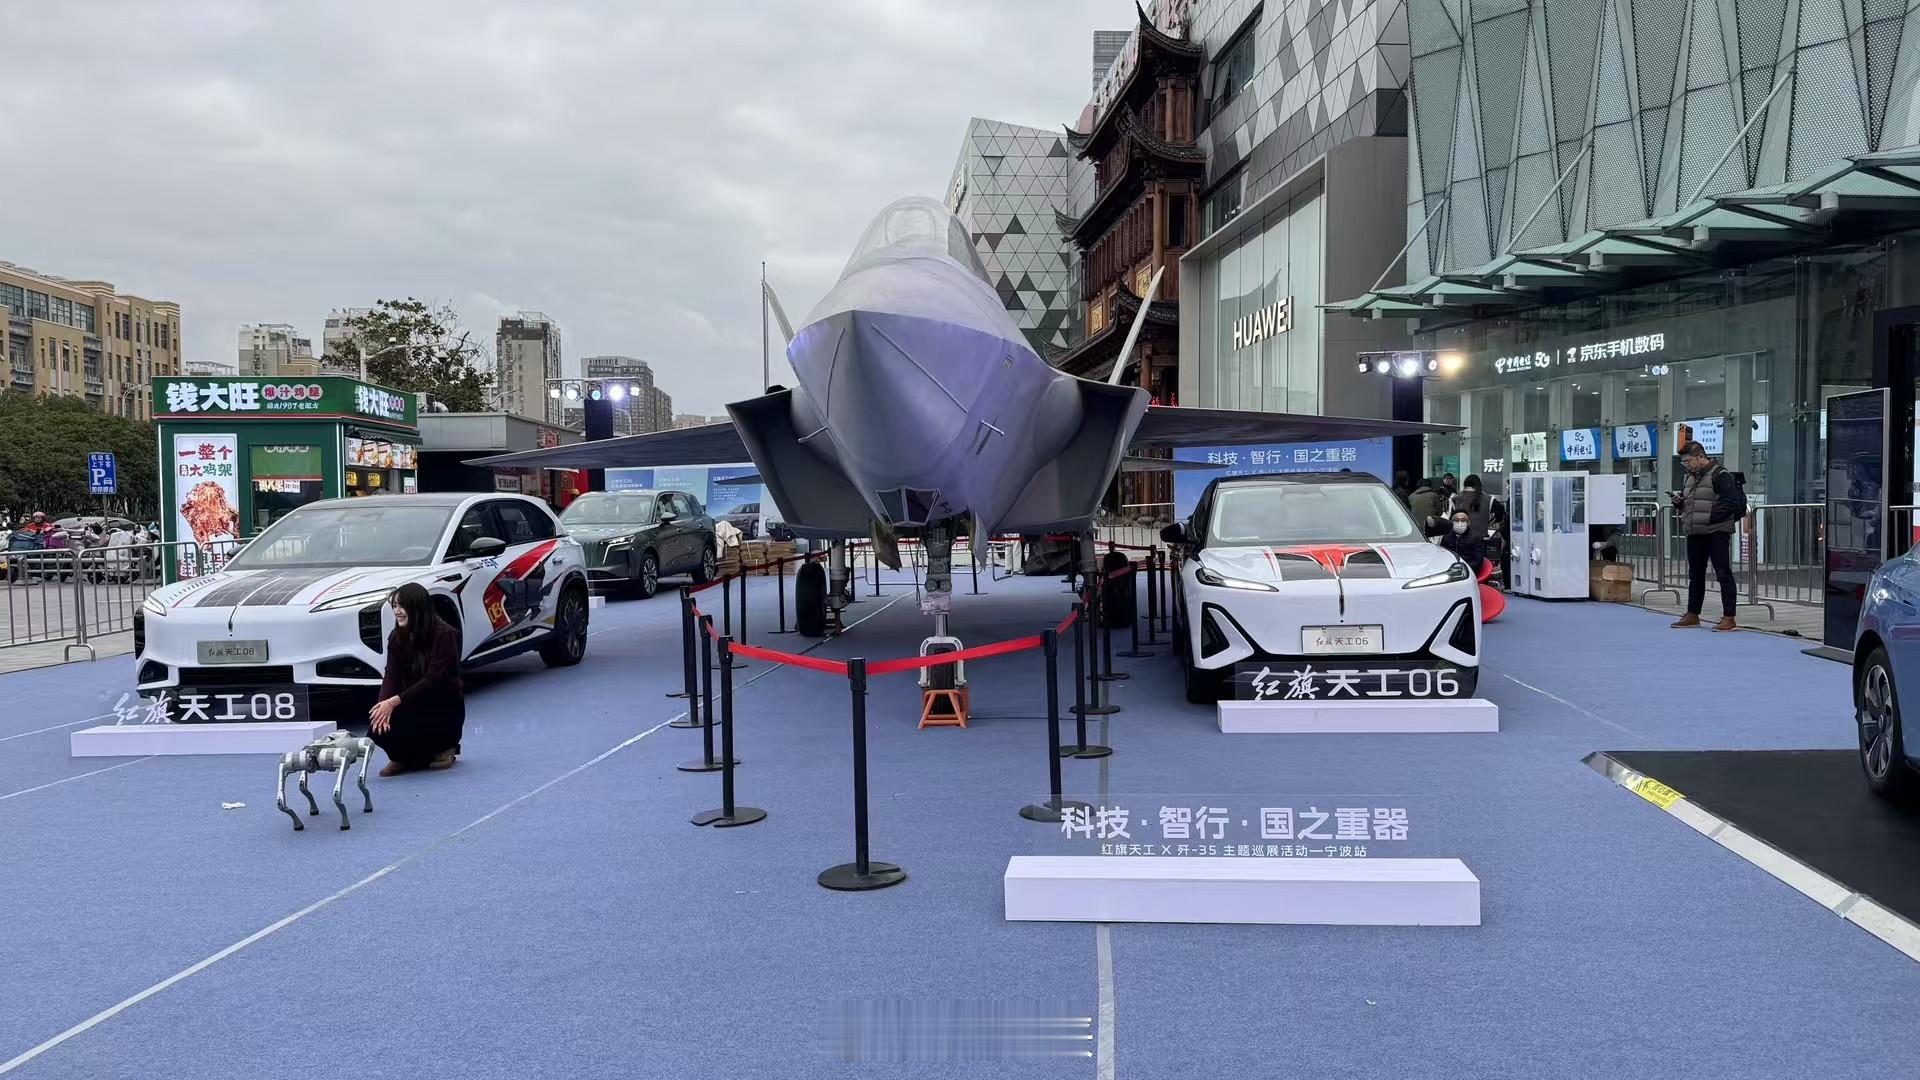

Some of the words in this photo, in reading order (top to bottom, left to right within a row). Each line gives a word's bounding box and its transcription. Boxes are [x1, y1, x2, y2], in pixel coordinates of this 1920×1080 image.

[1233, 296, 1293, 350] HUAWEI
[1580, 333, 1665, 362] 京东手机数码
[165, 382, 260, 412] 钱大旺
[178, 443, 233, 461] 一整个
[91, 468, 106, 486] P
[1252, 664, 1459, 703] 红旗天工06
[113, 690, 295, 726] 红旗天工08
[1101, 843, 1156, 856] 红旗天工
[1177, 844, 1217, 856] 歼-35
